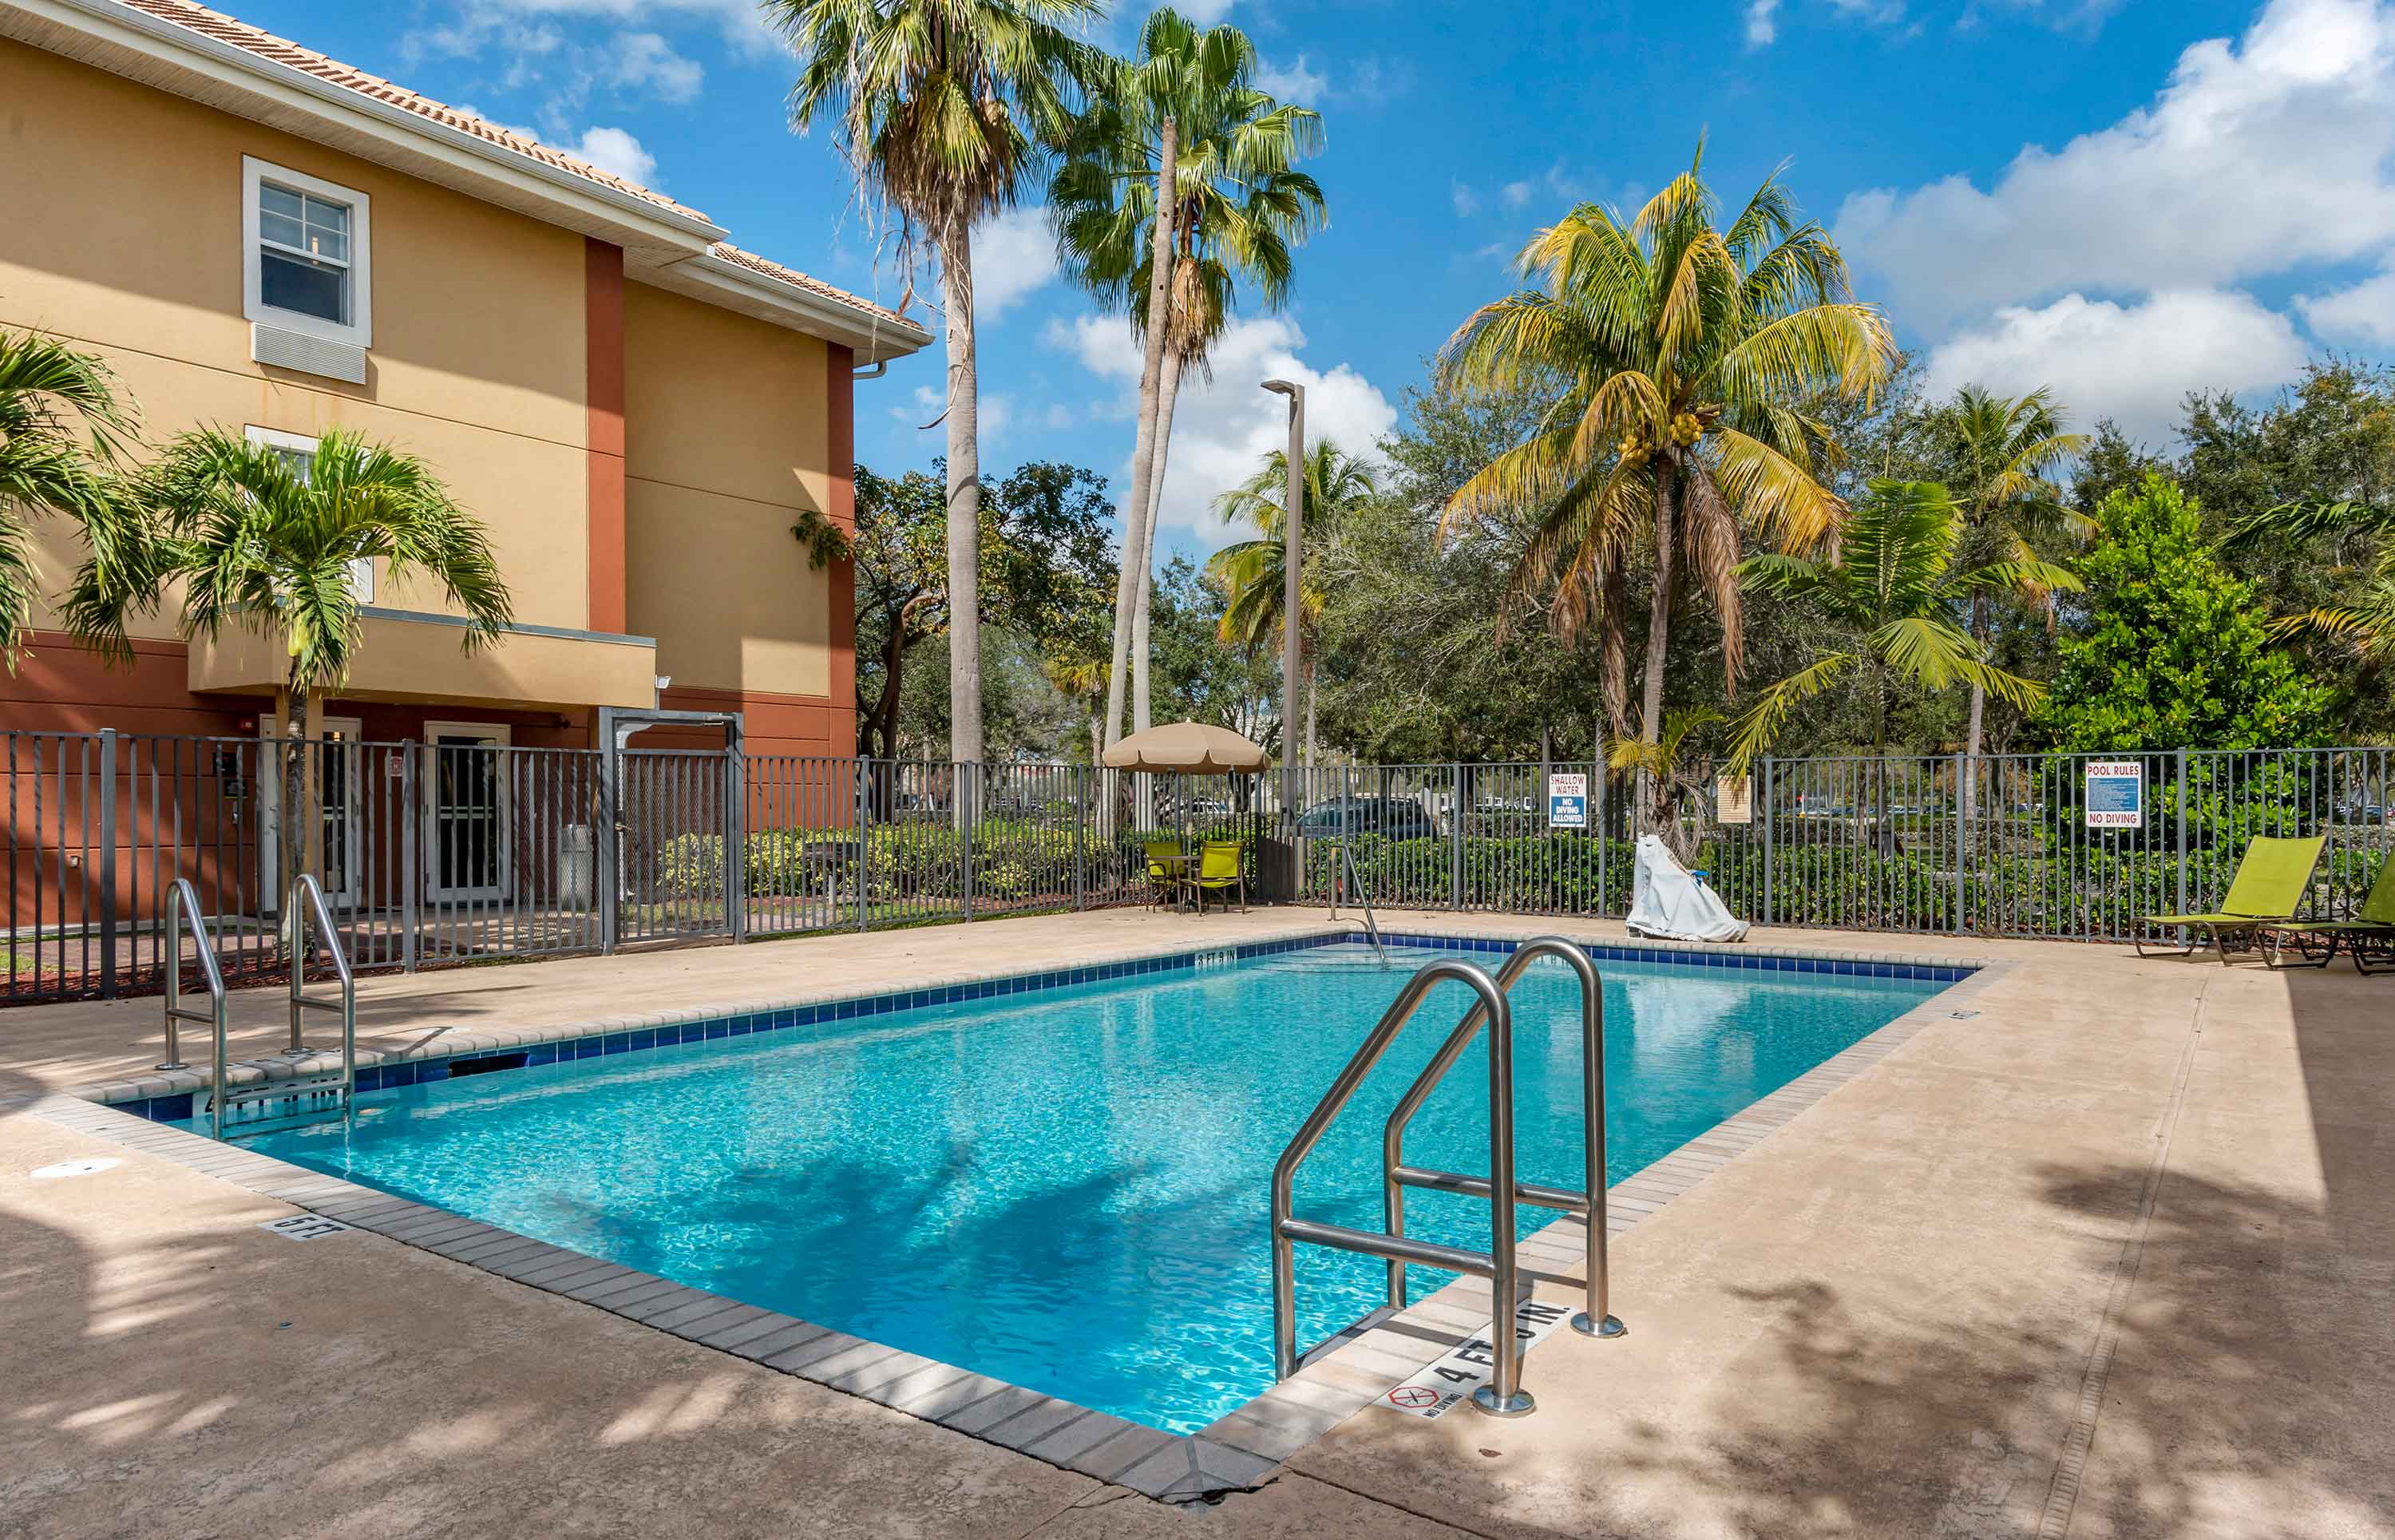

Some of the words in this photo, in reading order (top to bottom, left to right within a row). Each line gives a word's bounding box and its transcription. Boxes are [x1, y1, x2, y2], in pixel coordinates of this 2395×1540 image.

[2088, 766, 2110, 775] POOL
[2114, 766, 2139, 775] RULES
[1551, 776, 1585, 785] SHALLOW
[1556, 786, 1579, 794] WATER
[2089, 814, 2103, 823] NO
[2106, 814, 2137, 823] DIVING
[1206, 952, 1215, 964] FT
[1227, 950, 1235, 963] IN
[275, 1217, 318, 1227] 5
[1433, 1367, 1480, 1383] 4
[1423, 1408, 1440, 1418] NO
[1433, 1393, 1463, 1410] DIVING
